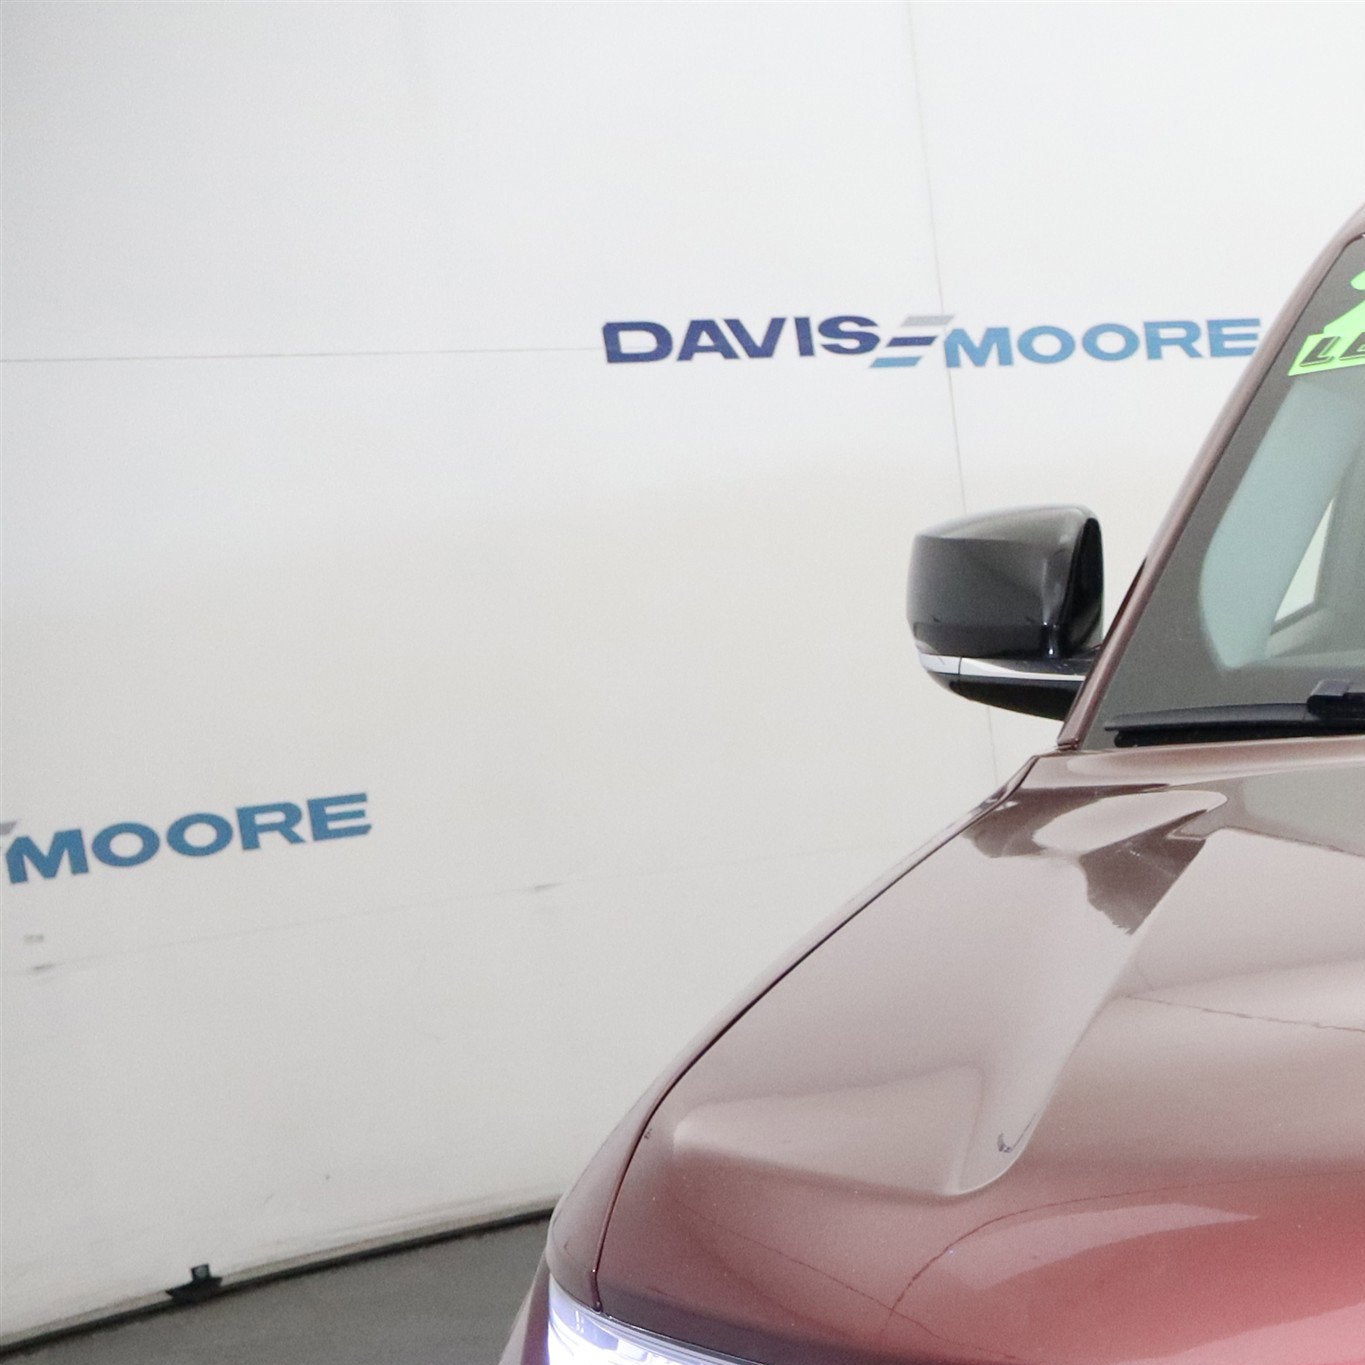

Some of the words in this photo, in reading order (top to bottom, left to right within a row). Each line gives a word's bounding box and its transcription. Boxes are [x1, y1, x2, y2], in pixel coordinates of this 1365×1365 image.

[601, 314, 879, 364] DAVIS
[943, 317, 1260, 369] MOORE
[4, 792, 372, 885] MOORE
